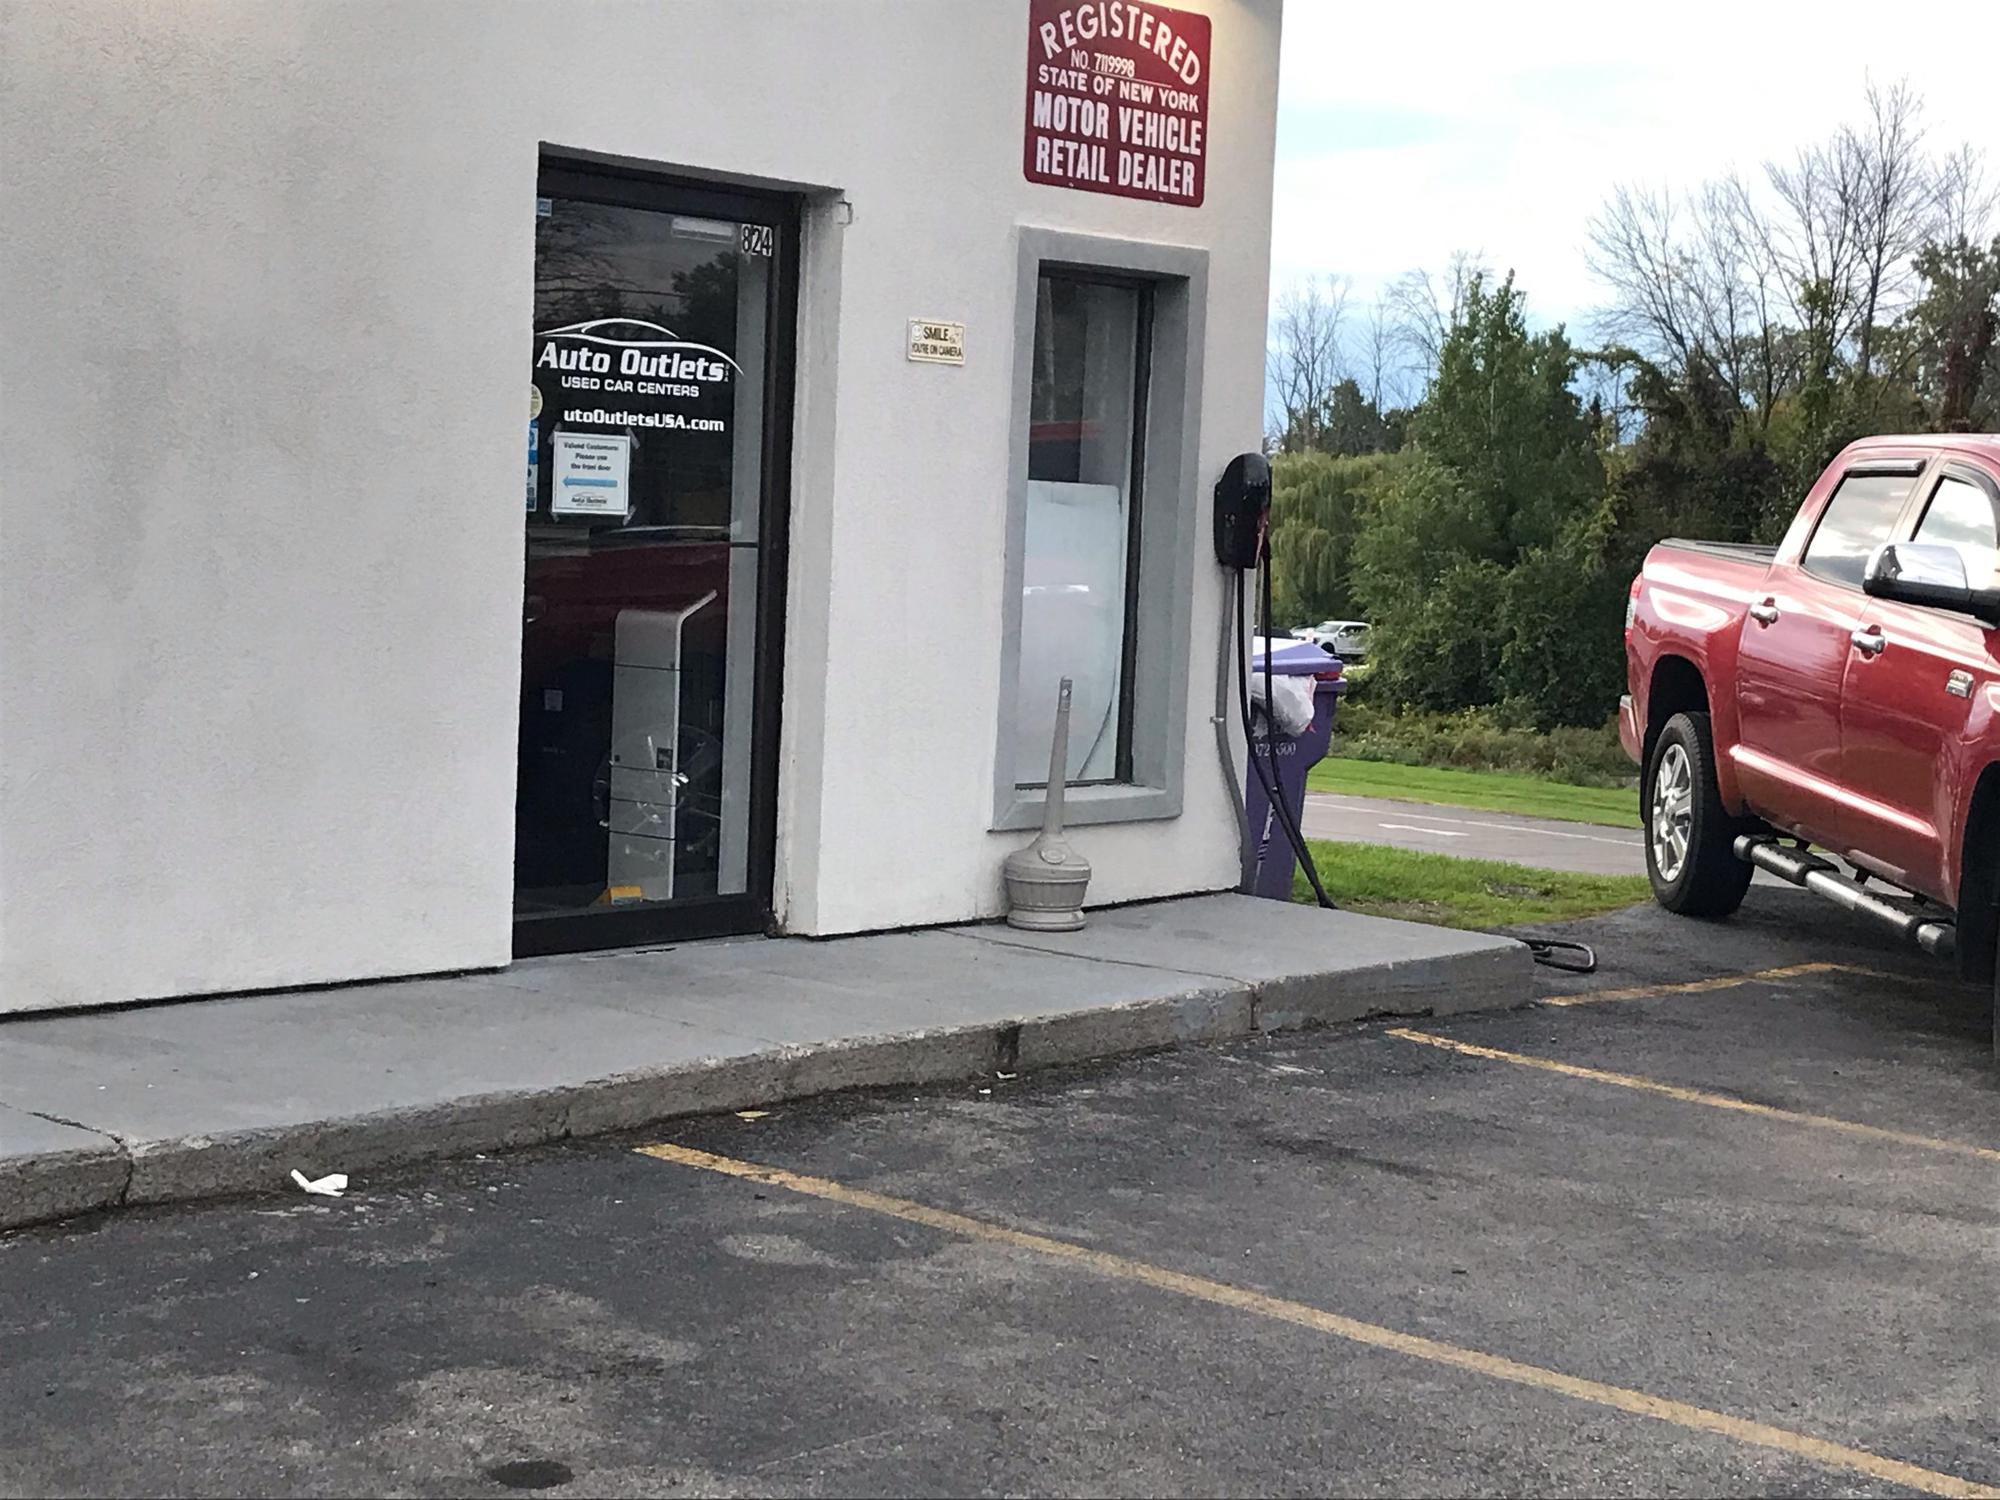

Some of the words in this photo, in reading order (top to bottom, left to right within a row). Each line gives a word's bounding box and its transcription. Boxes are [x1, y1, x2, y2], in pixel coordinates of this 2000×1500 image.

[1040, 1, 1200, 85] REGISTERED
[1071, 49, 1091, 71] NO.
[1094, 52, 1136, 78] 7119998
[1038, 64, 1088, 91] STATE
[1093, 77, 1115, 96] OF
[1119, 81, 1154, 104] NEW
[1159, 89, 1199, 113] YORK
[1033, 91, 1109, 139] MOTOR
[1118, 106, 1202, 156] VEHICLE
[1035, 136, 1110, 183] RETAIL
[1118, 150, 1195, 197] DEALER
[742, 225, 772, 256] 824
[923, 326, 949, 341] SMILE
[536, 342, 611, 373] Auto
[620, 348, 725, 382] Outlets
[561, 376, 601, 390] USED
[604, 379, 633, 392] CAR
[637, 381, 700, 397] CENTERS
